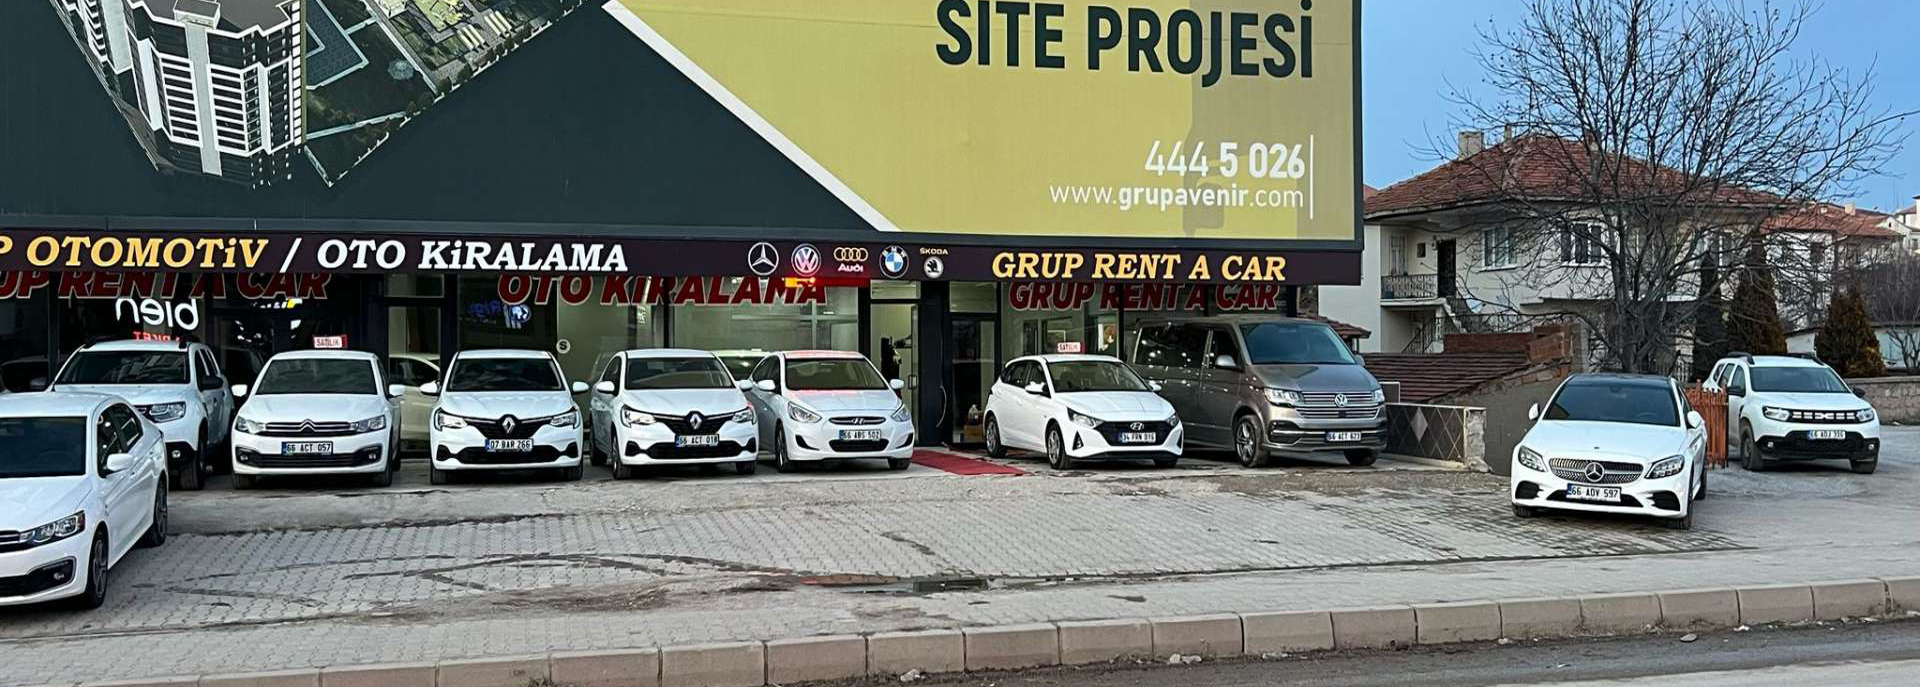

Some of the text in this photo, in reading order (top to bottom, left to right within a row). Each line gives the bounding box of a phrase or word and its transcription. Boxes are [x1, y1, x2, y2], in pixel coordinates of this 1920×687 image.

[1088, 0, 1313, 87] PROJESİ
[1145, 141, 1305, 178] 444 5 026
[1050, 184, 1303, 211] www.grupavenir.com
[317, 239, 406, 269] OTO
[992, 252, 1286, 281] GRUP RENT A CAR
[498, 274, 594, 305] OTO
[1009, 282, 1280, 311] GRUP RENT A CAR
[287, 443, 331, 452] 66 ACT 057
[490, 440, 530, 449] 07 BAR 266
[1571, 485, 1582, 496] 66
[1603, 489, 1618, 498] 597
